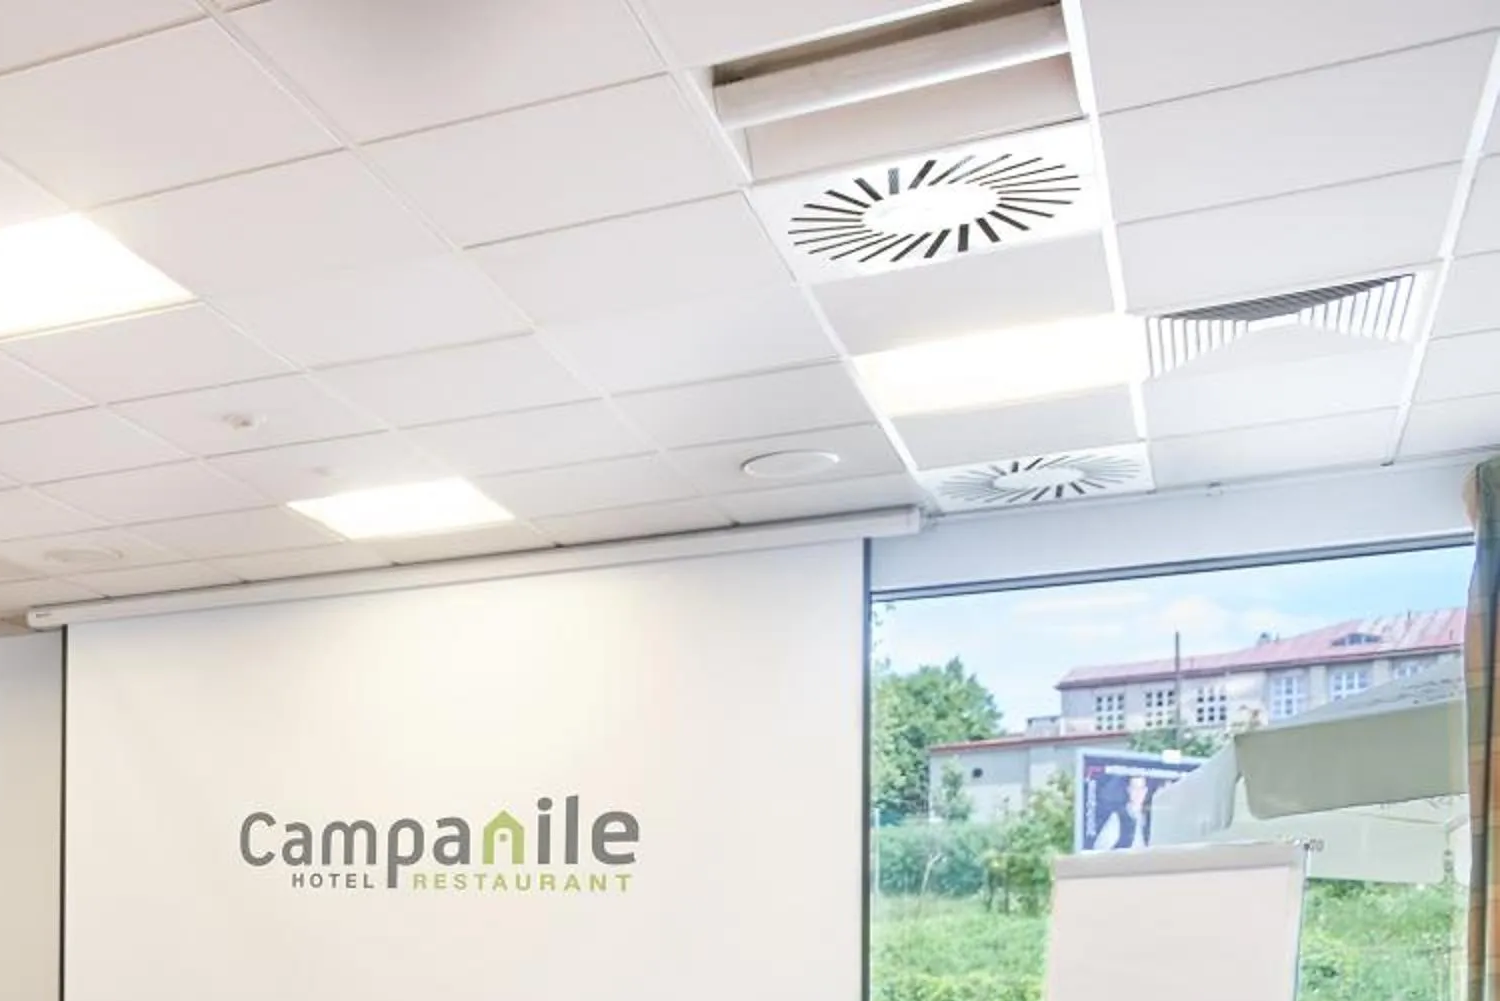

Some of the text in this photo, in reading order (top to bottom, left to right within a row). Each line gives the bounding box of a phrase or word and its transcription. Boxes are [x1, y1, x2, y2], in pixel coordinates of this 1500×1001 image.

[239, 794, 640, 889] Campanile
[291, 872, 633, 892] HOTEL RESTAURANT
